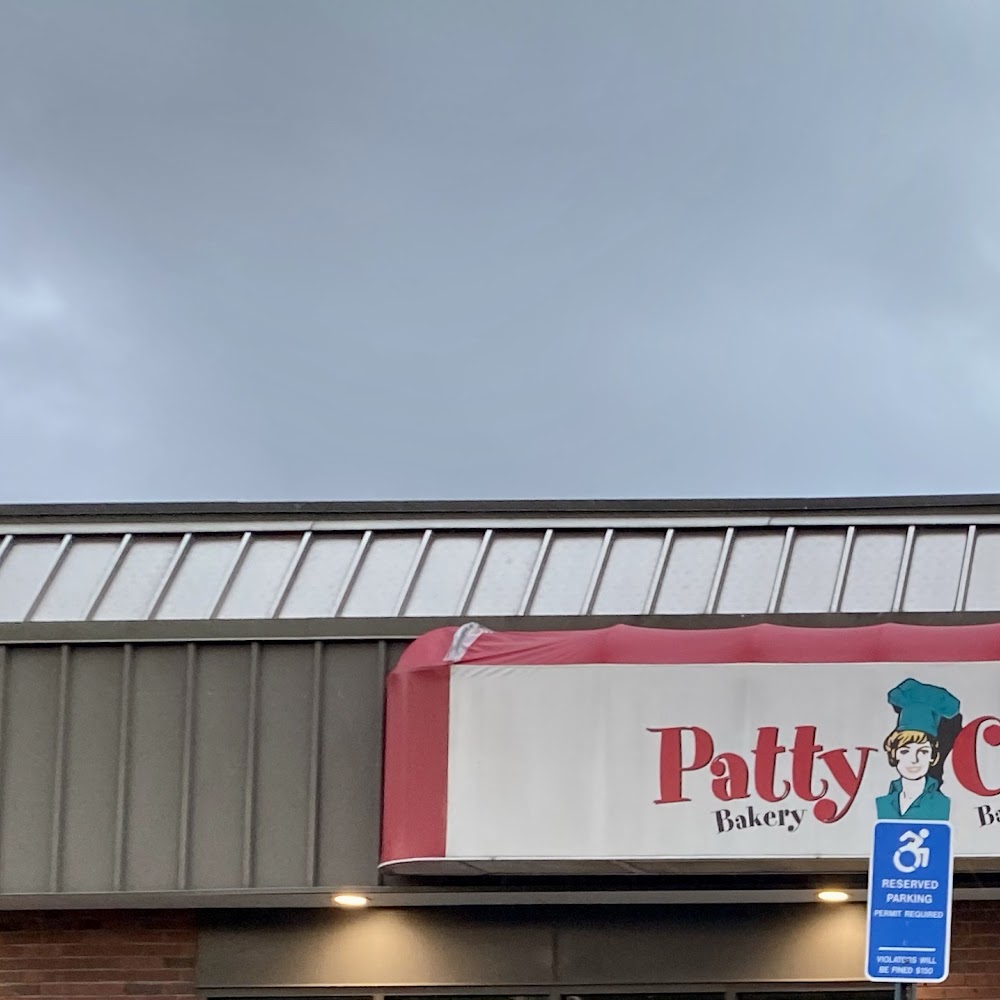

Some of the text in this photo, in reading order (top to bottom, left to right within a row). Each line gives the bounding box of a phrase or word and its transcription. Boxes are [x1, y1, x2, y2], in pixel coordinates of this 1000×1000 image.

[646, 726, 878, 823] Patty
[711, 806, 807, 834] Bakery
[882, 879, 939, 889] RESERVED
[886, 893, 933, 904] PARKING
[874, 909, 944, 919] PERMIT REQUIRED
[919, 956, 937, 965] WILL
[878, 965, 890, 974] BE
[891, 965, 914, 975] FINED
